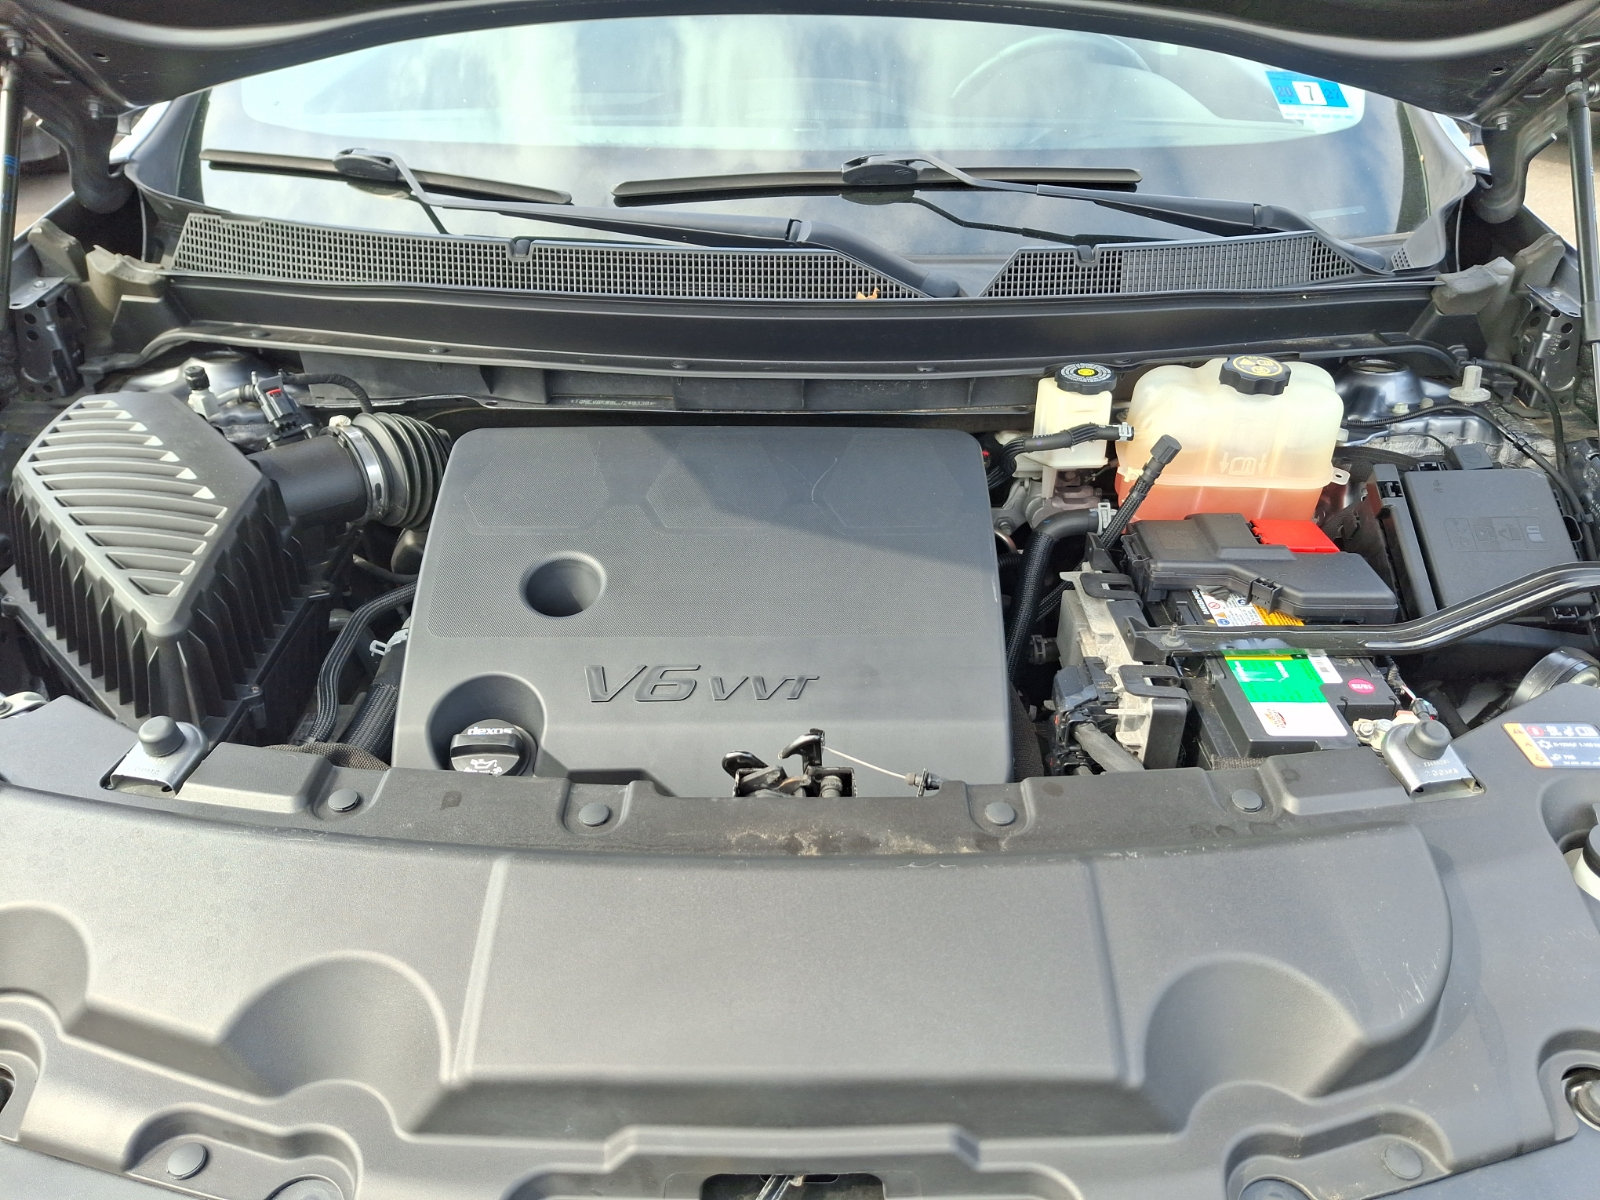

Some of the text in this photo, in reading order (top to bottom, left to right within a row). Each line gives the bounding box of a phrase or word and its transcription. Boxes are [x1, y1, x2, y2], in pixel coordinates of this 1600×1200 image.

[1303, 85, 1314, 101] 7
[584, 663, 820, 703] V6 VVT
[467, 726, 514, 736] dexos
